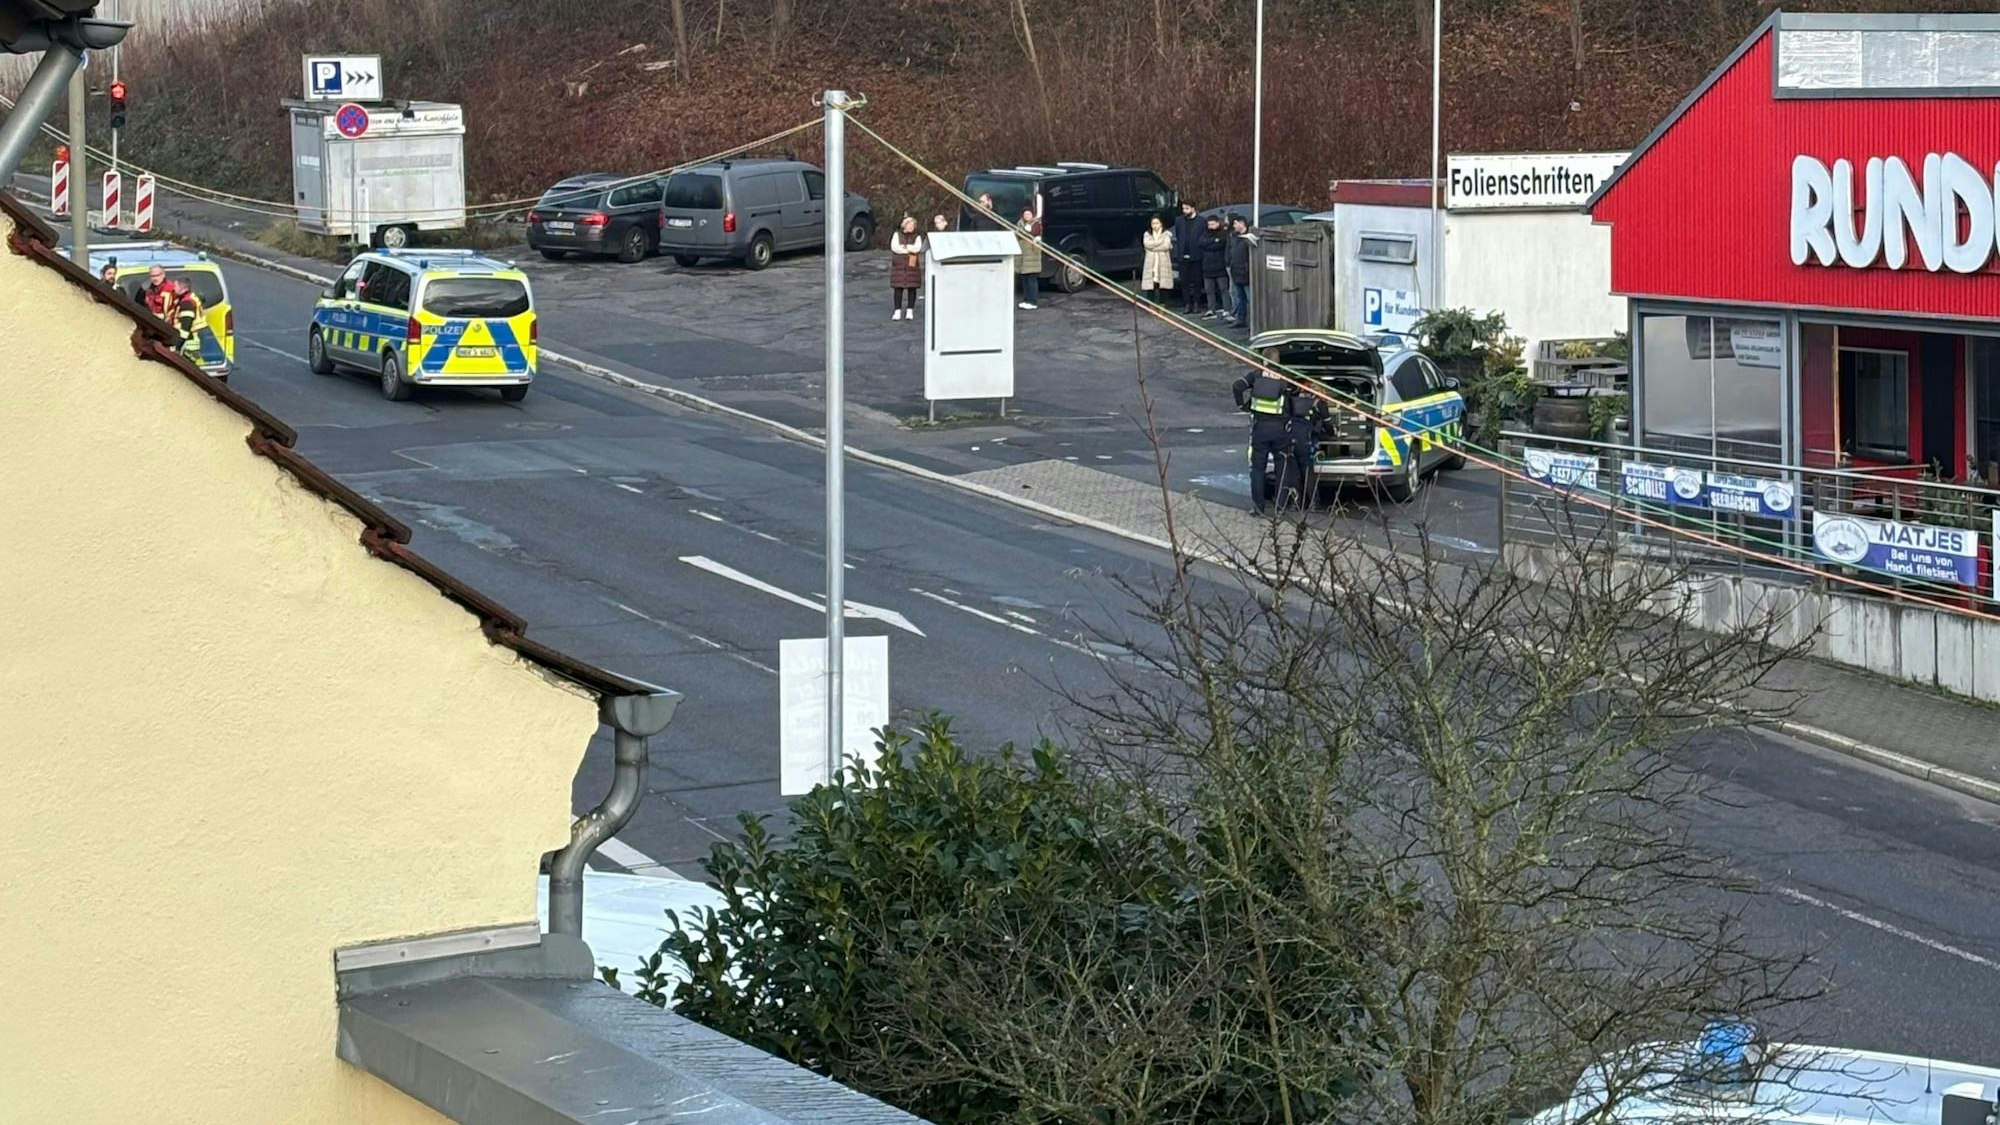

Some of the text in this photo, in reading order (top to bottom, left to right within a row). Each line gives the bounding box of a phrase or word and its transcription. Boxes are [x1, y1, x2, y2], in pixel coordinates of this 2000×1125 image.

[316, 63, 336, 89] P
[1451, 166, 1594, 197] Folienschriften
[1789, 151, 2000, 274] RUND
[421, 325, 464, 335] POLIZEI
[1879, 523, 1963, 552] MATJES
[1885, 560, 1913, 574] Hand
[1891, 549, 1953, 567] Bei uns von
